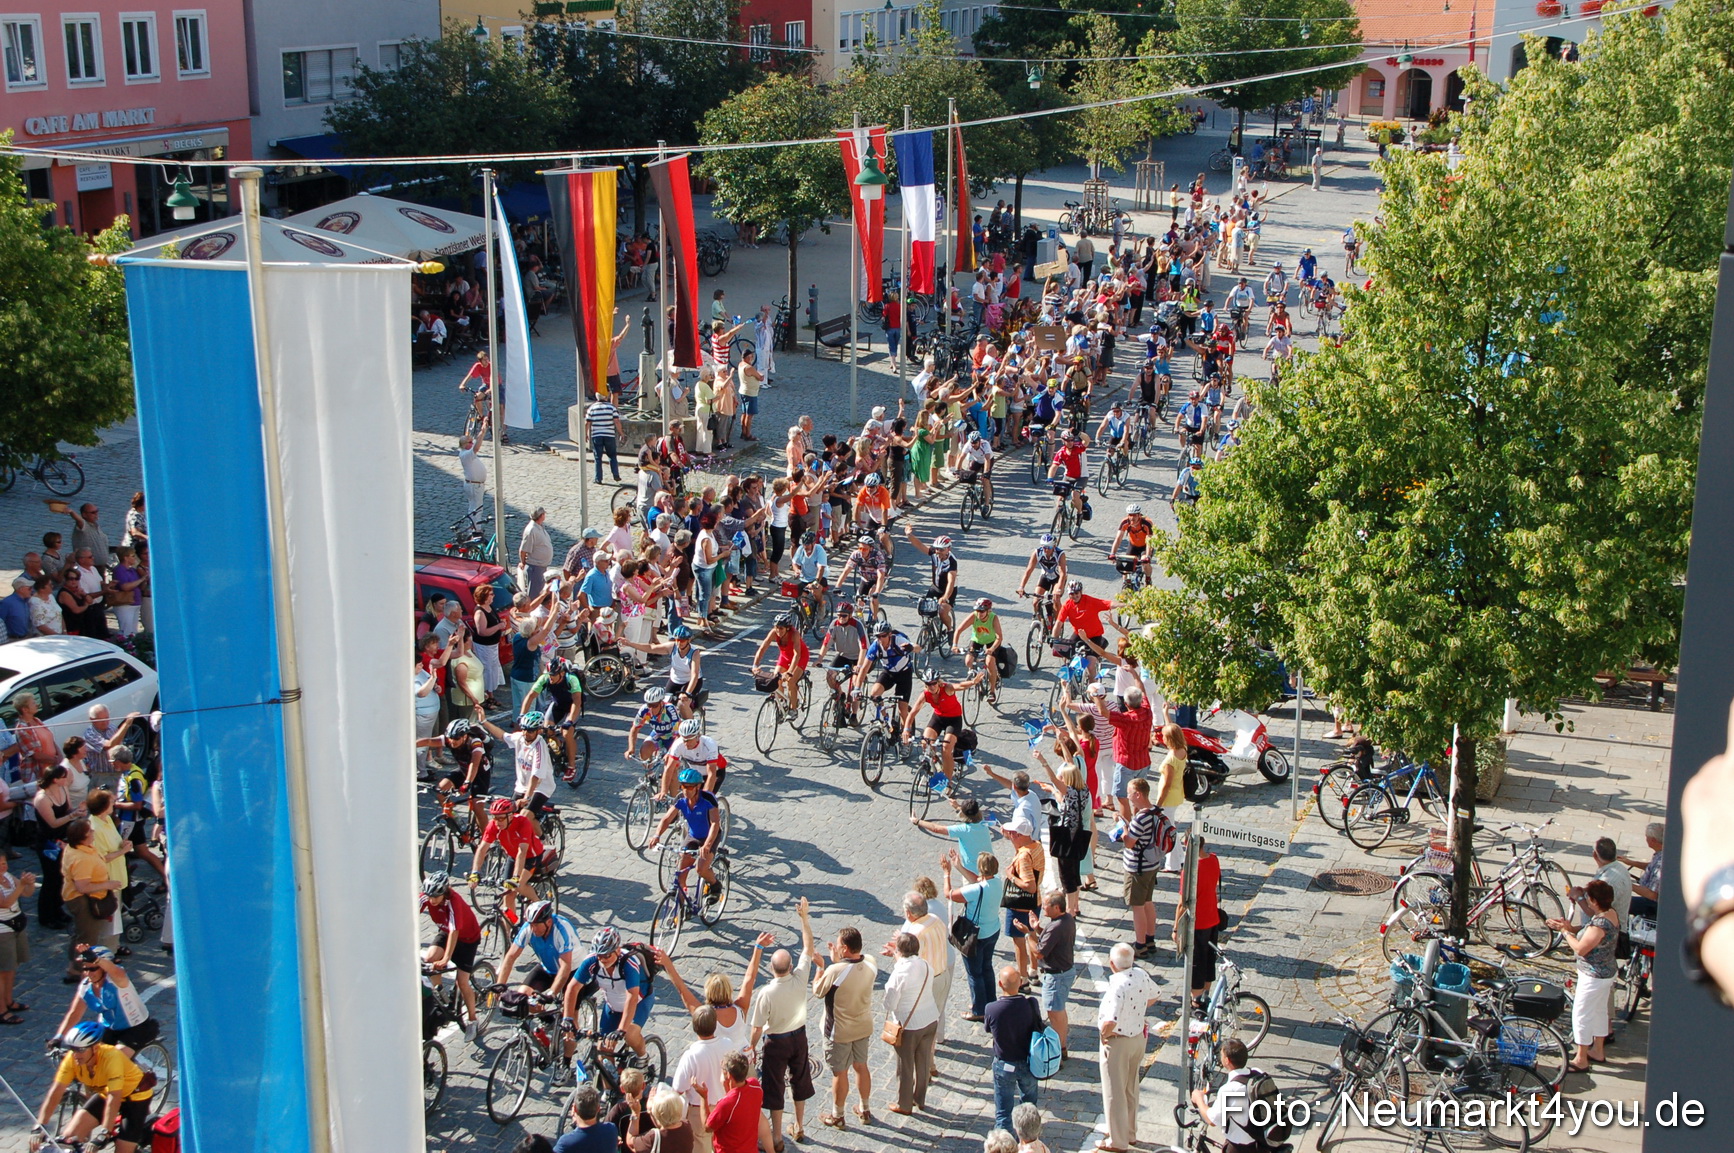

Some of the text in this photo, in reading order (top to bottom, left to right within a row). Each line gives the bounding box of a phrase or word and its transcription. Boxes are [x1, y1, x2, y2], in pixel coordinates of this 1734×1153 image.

[1386, 56, 1444, 67] Spkasse
[25, 107, 156, 136] CAFE AM MARKT
[103, 146, 131, 157] MARKT
[1202, 821, 1286, 848] Brunnwirtsgasse
